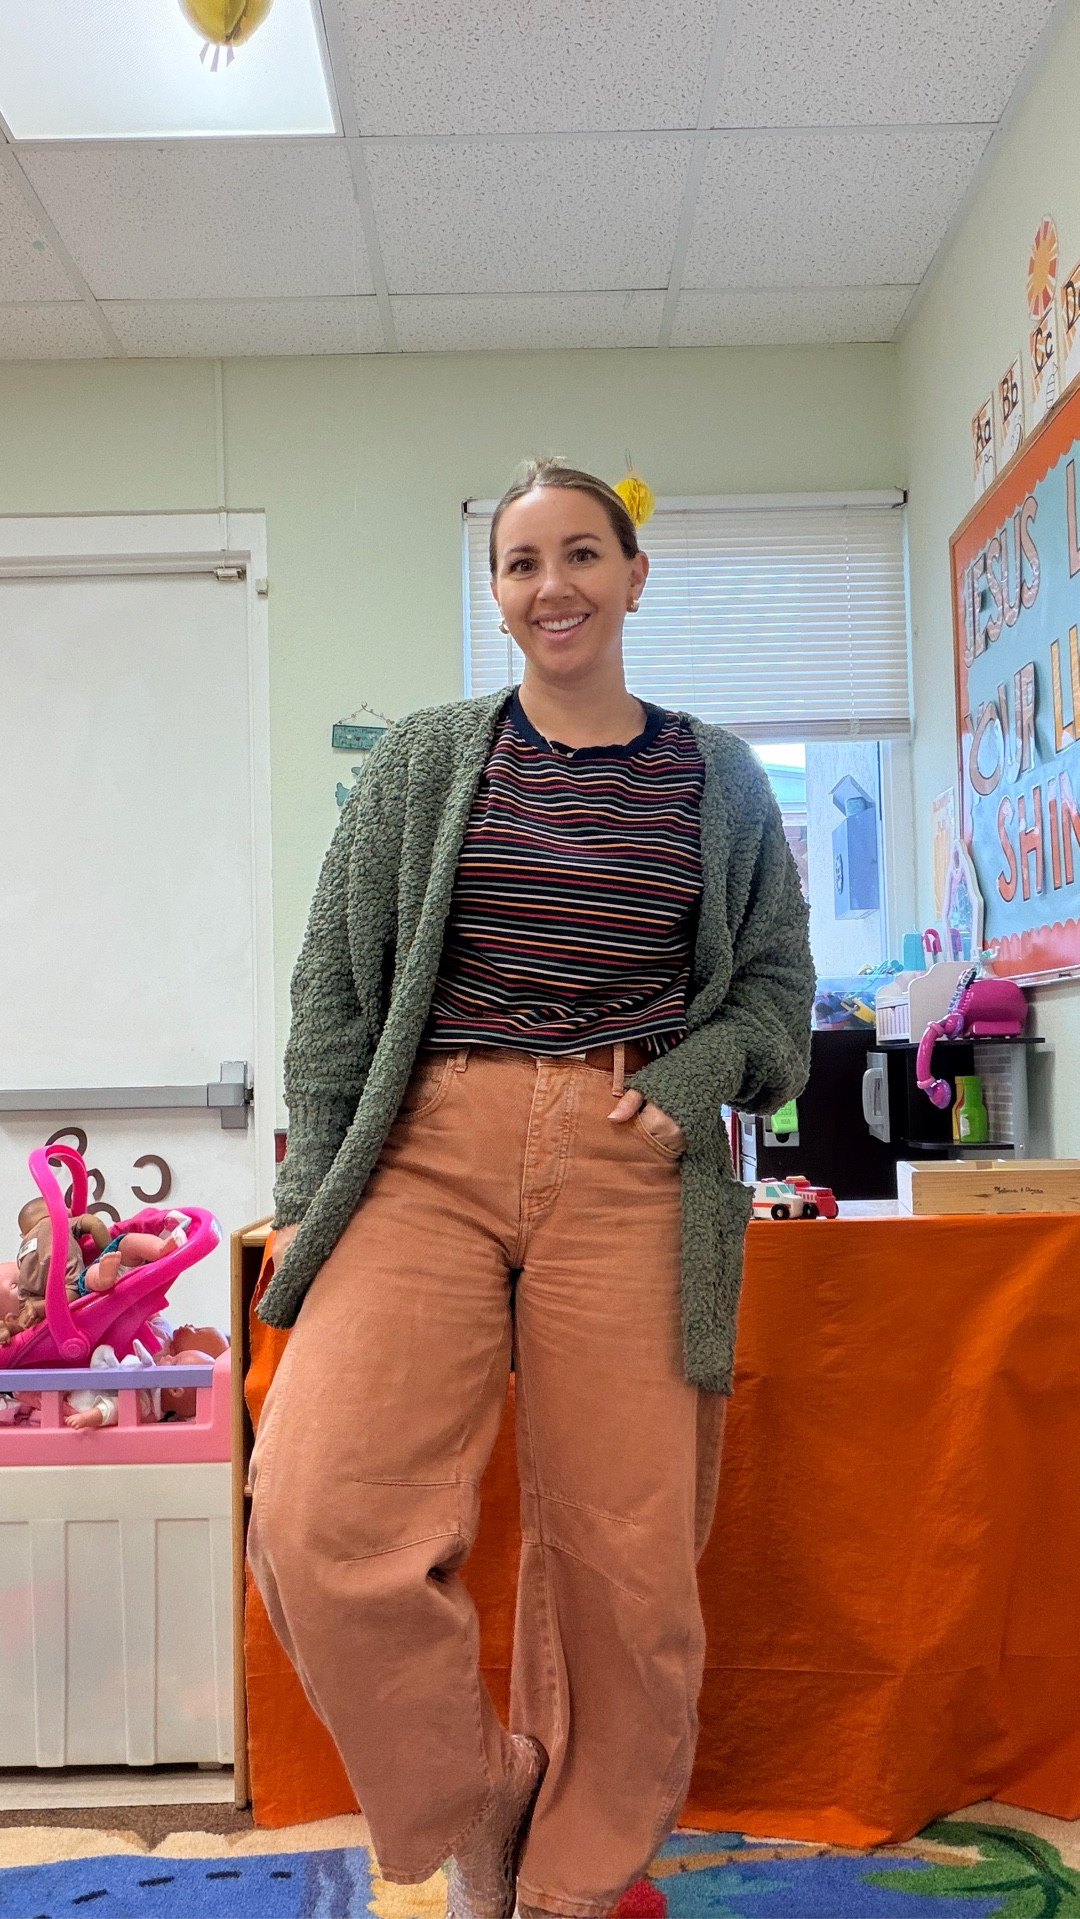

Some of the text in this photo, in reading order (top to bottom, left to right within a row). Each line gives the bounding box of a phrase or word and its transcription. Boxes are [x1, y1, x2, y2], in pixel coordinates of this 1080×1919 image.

[1064, 280, 1080, 333] D
[1034, 327, 1054, 372] Cc
[1002, 370, 1019, 423] Bb
[975, 416, 991, 459] Aa
[964, 495, 1040, 668] JESUS
